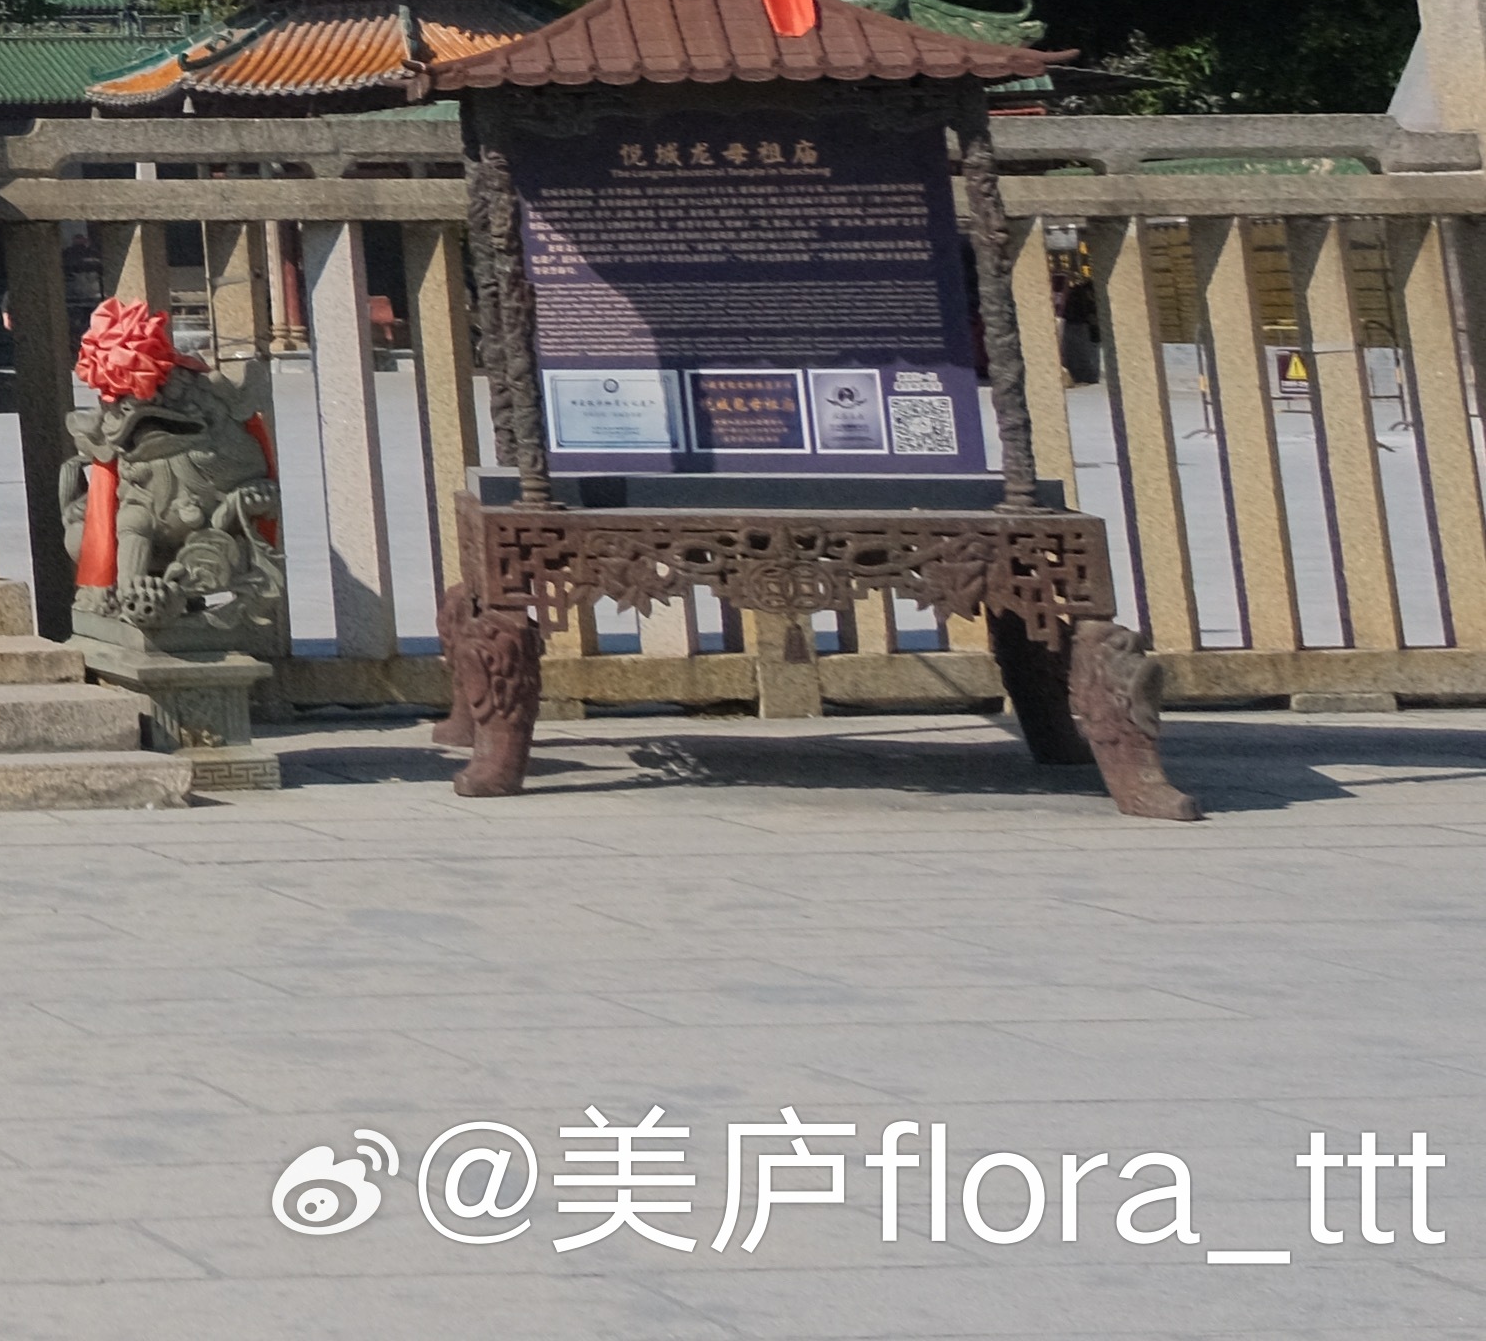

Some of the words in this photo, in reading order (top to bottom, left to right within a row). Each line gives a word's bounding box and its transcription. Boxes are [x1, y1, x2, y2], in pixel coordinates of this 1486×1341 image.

[619, 139, 818, 166] 悦城龙母祖庙
